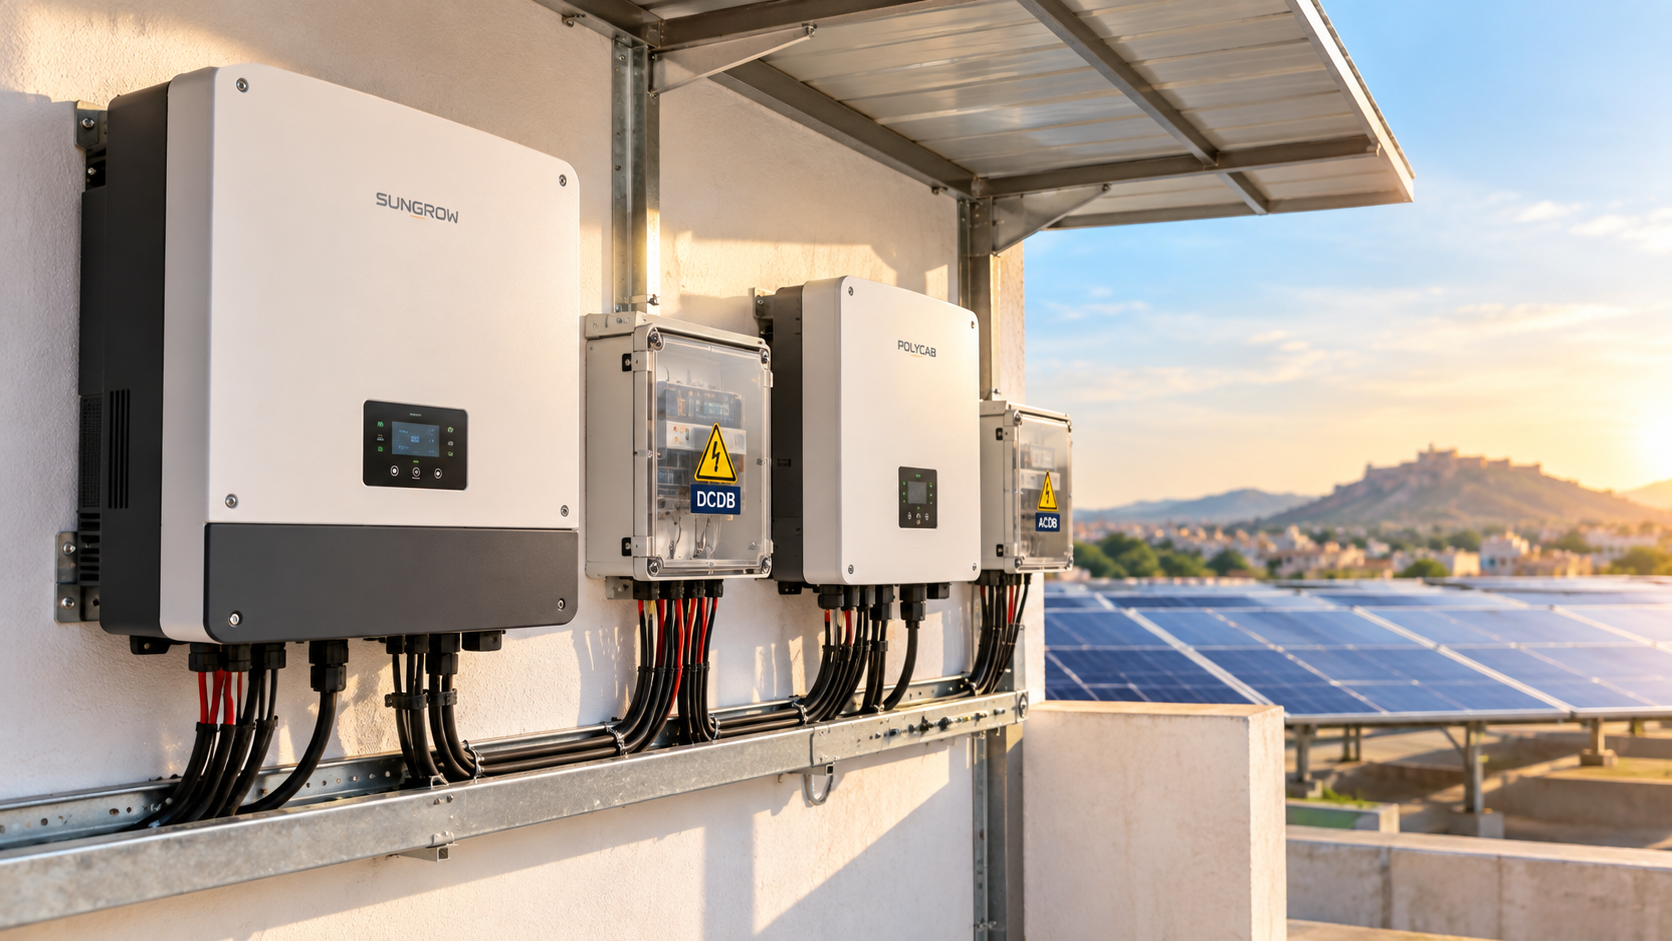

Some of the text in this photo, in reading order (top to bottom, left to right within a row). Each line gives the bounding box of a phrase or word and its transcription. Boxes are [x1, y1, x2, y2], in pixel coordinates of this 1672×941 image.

[376, 192, 459, 224] SUNGROW
[897, 340, 937, 358] POLYCAB
[696, 490, 736, 509] DCDB
[1038, 516, 1058, 529] ACDB
